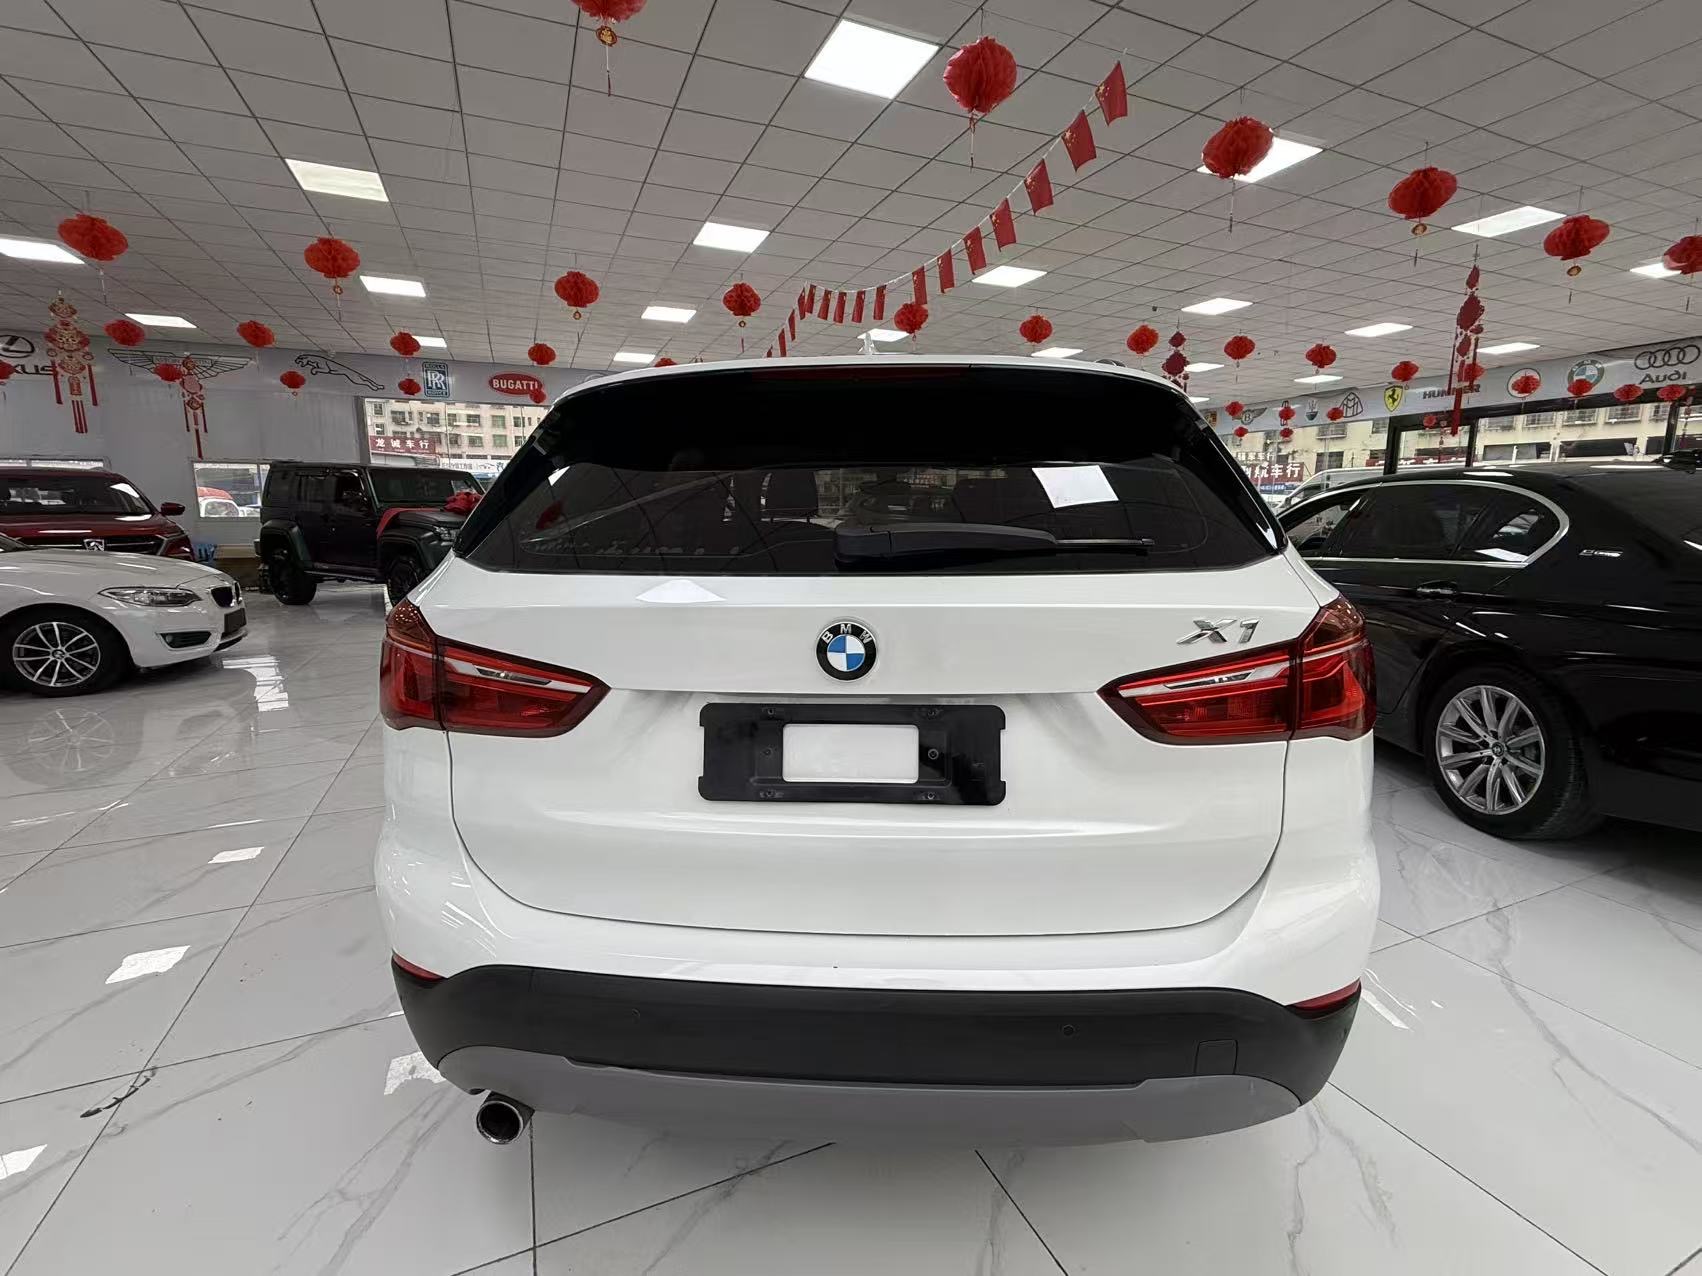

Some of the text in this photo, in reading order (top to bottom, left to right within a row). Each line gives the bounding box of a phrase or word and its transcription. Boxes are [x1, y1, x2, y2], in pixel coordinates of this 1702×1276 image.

[492, 379, 538, 390] BUGATTI
[1639, 370, 1688, 385] Audi
[821, 623, 873, 644] BMW
[1176, 619, 1260, 644] X1
